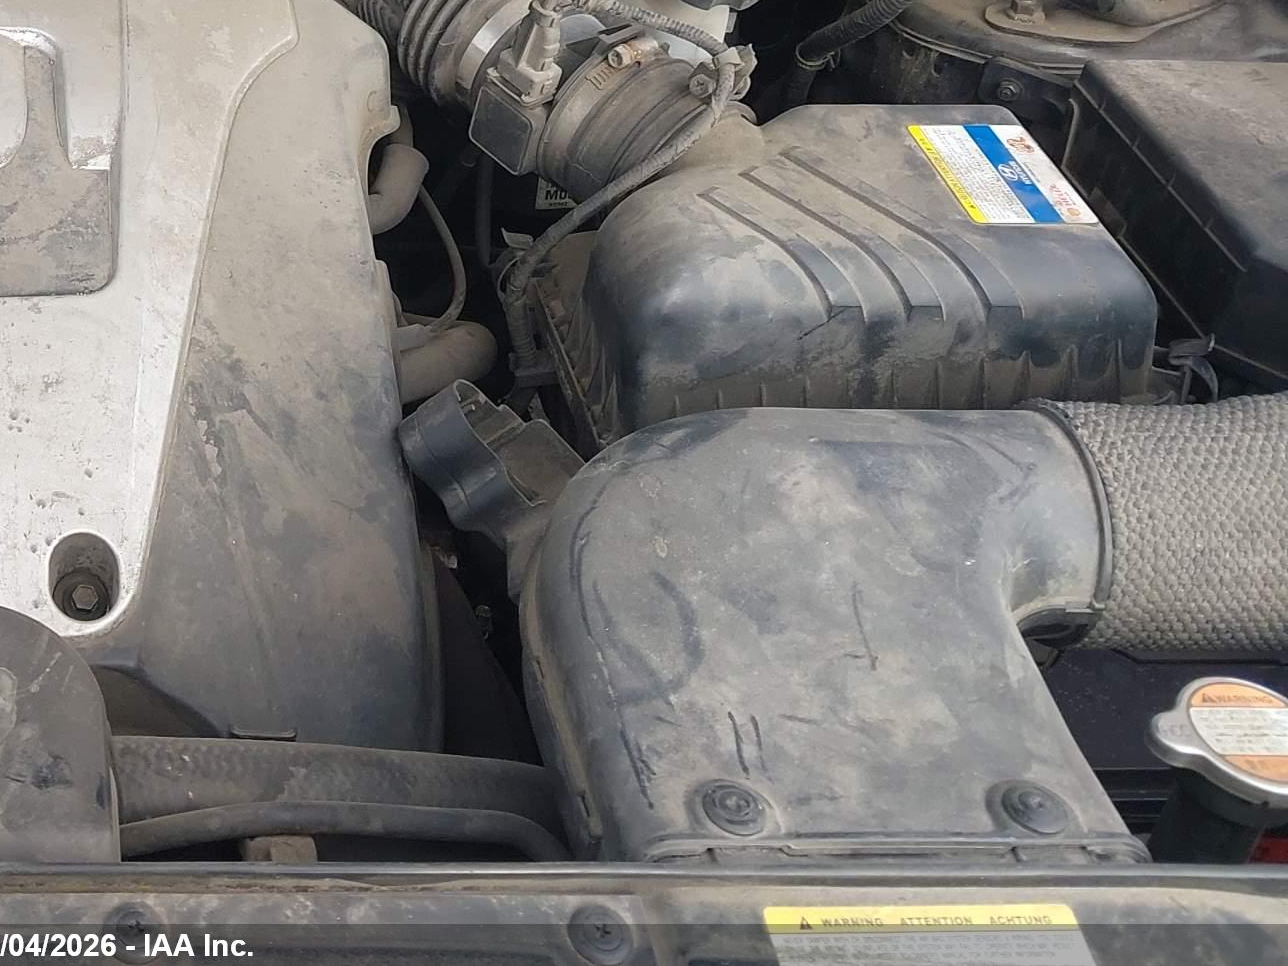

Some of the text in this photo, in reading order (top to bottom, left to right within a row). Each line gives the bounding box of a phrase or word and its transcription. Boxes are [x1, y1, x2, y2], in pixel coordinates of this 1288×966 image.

[820, 916, 1052, 928] WARNING ATTENTION ACHTUNG
